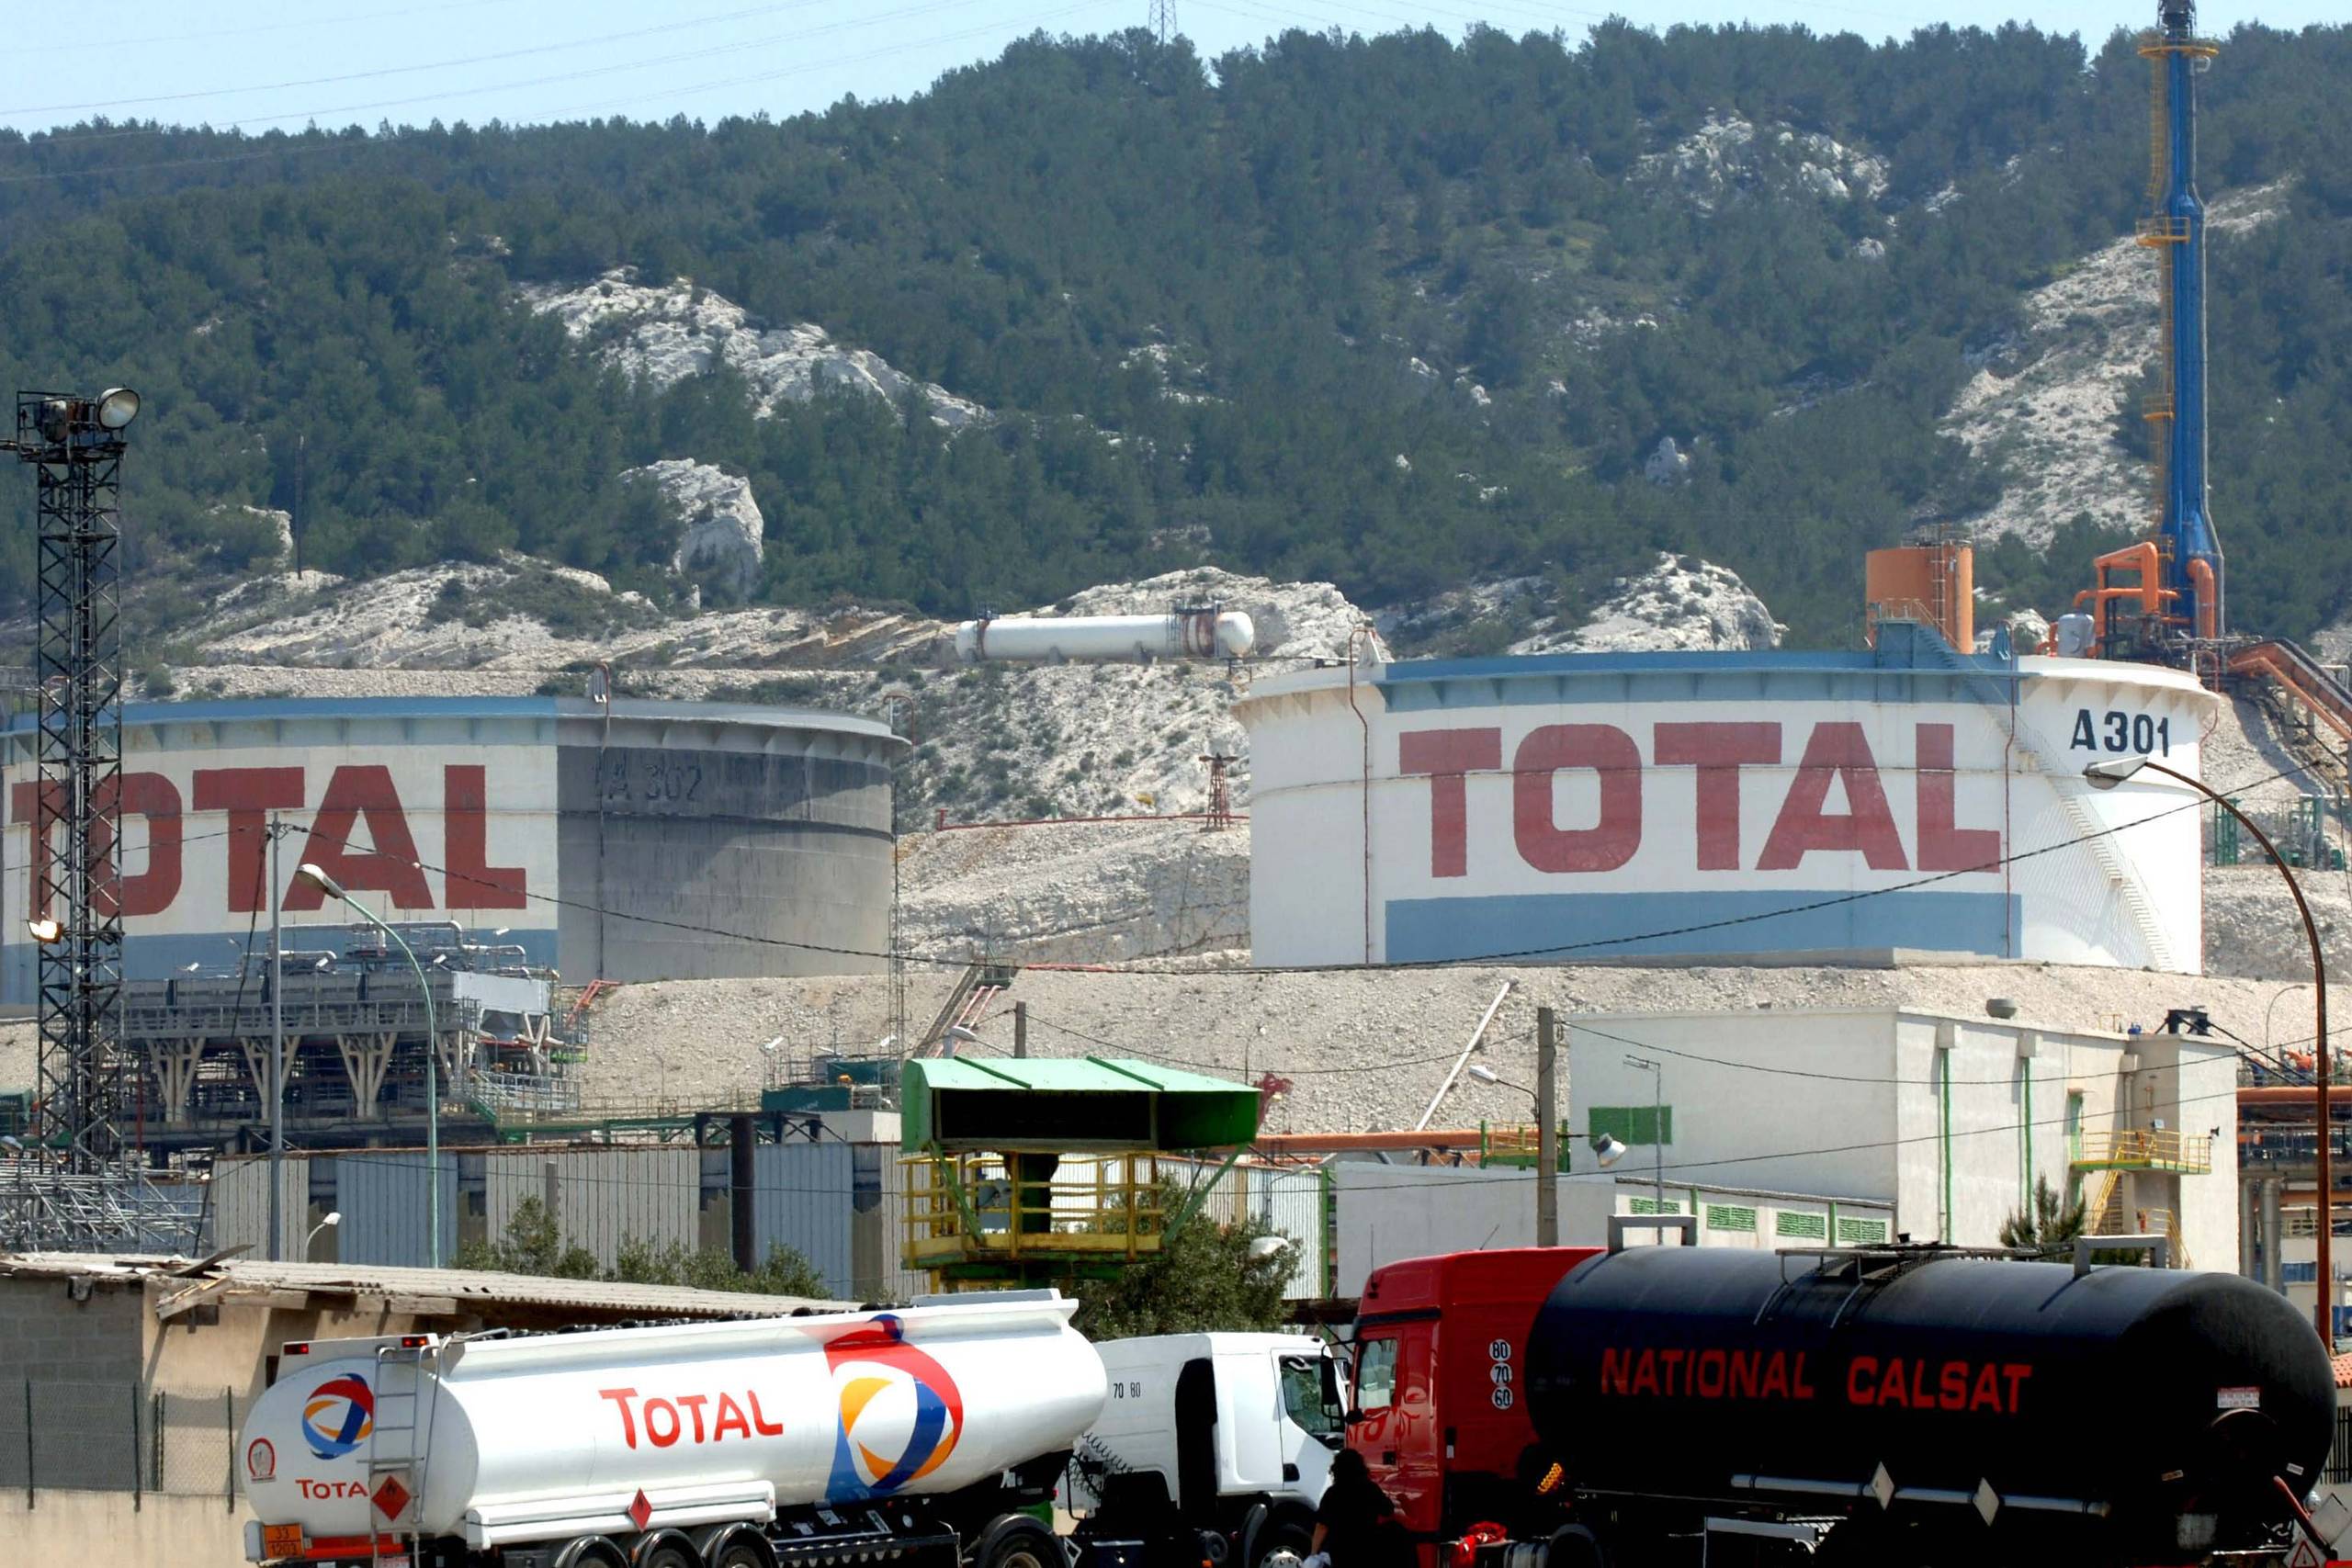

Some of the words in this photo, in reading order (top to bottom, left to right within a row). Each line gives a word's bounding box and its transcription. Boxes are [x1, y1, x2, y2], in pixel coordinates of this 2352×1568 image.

[1399, 722, 1997, 878] TOTAL
[11, 764, 526, 919] TOTAL
[1491, 1341, 1509, 1359] 80
[1494, 1366, 1510, 1383] 70
[1601, 1348, 1815, 1399] NATIONAL
[1847, 1356, 2033, 1413] CALSAT
[1113, 1382, 1124, 1399] 70
[1130, 1382, 1141, 1398] 80
[1494, 1389, 1511, 1407] 60
[600, 1388, 784, 1450] TOTAL
[295, 1478, 369, 1501] TOTA
[276, 1527, 290, 1540] 33
